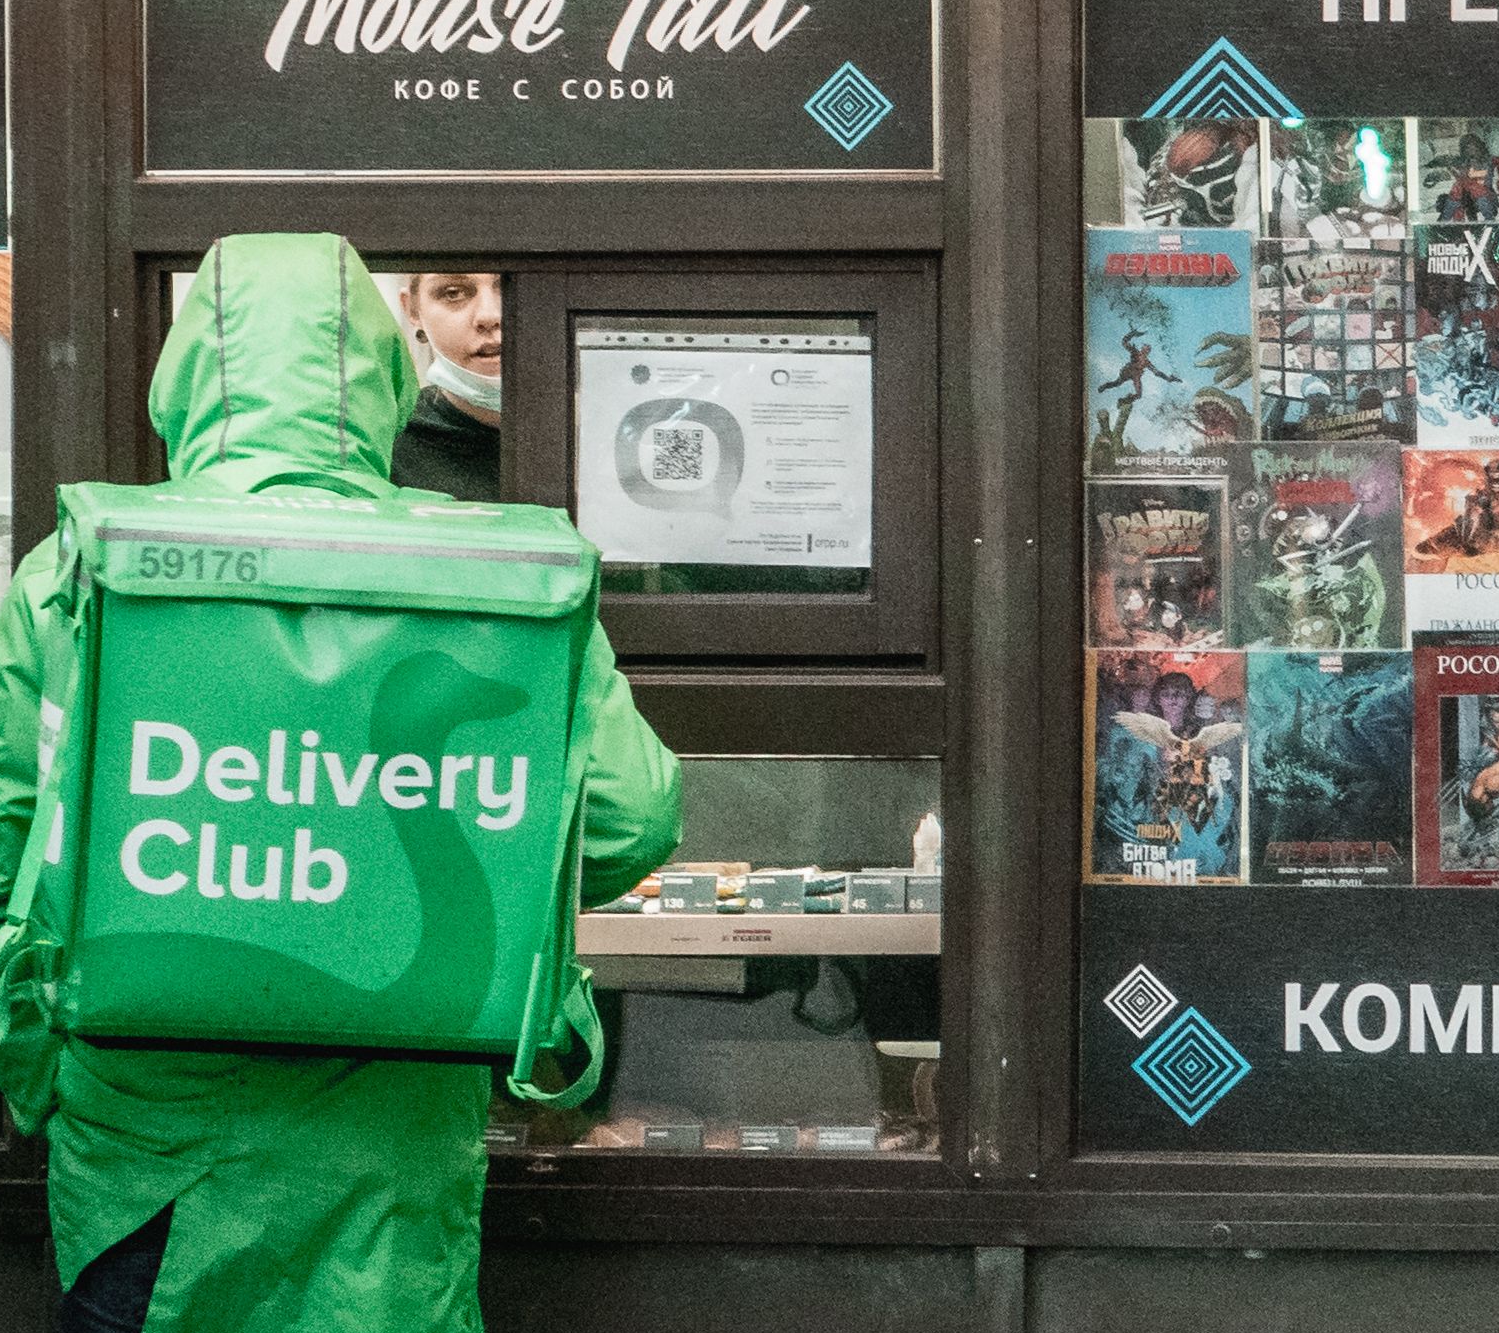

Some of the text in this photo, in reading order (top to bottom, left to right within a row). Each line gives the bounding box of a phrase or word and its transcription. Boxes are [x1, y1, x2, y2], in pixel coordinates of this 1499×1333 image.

[394, 74, 676, 102] КОФЕ С СОБОЙ
[1428, 242, 1469, 256] НОВЫЕ
[1427, 255, 1470, 276] ЛЮДИ
[138, 544, 260, 585] 59176
[128, 719, 530, 832] Delivery
[118, 817, 350, 905] Club
[1122, 841, 1168, 862] БИТВА
[1132, 858, 1198, 886] АТОМА
[663, 898, 685, 909] 130
[851, 898, 868, 909] 45
